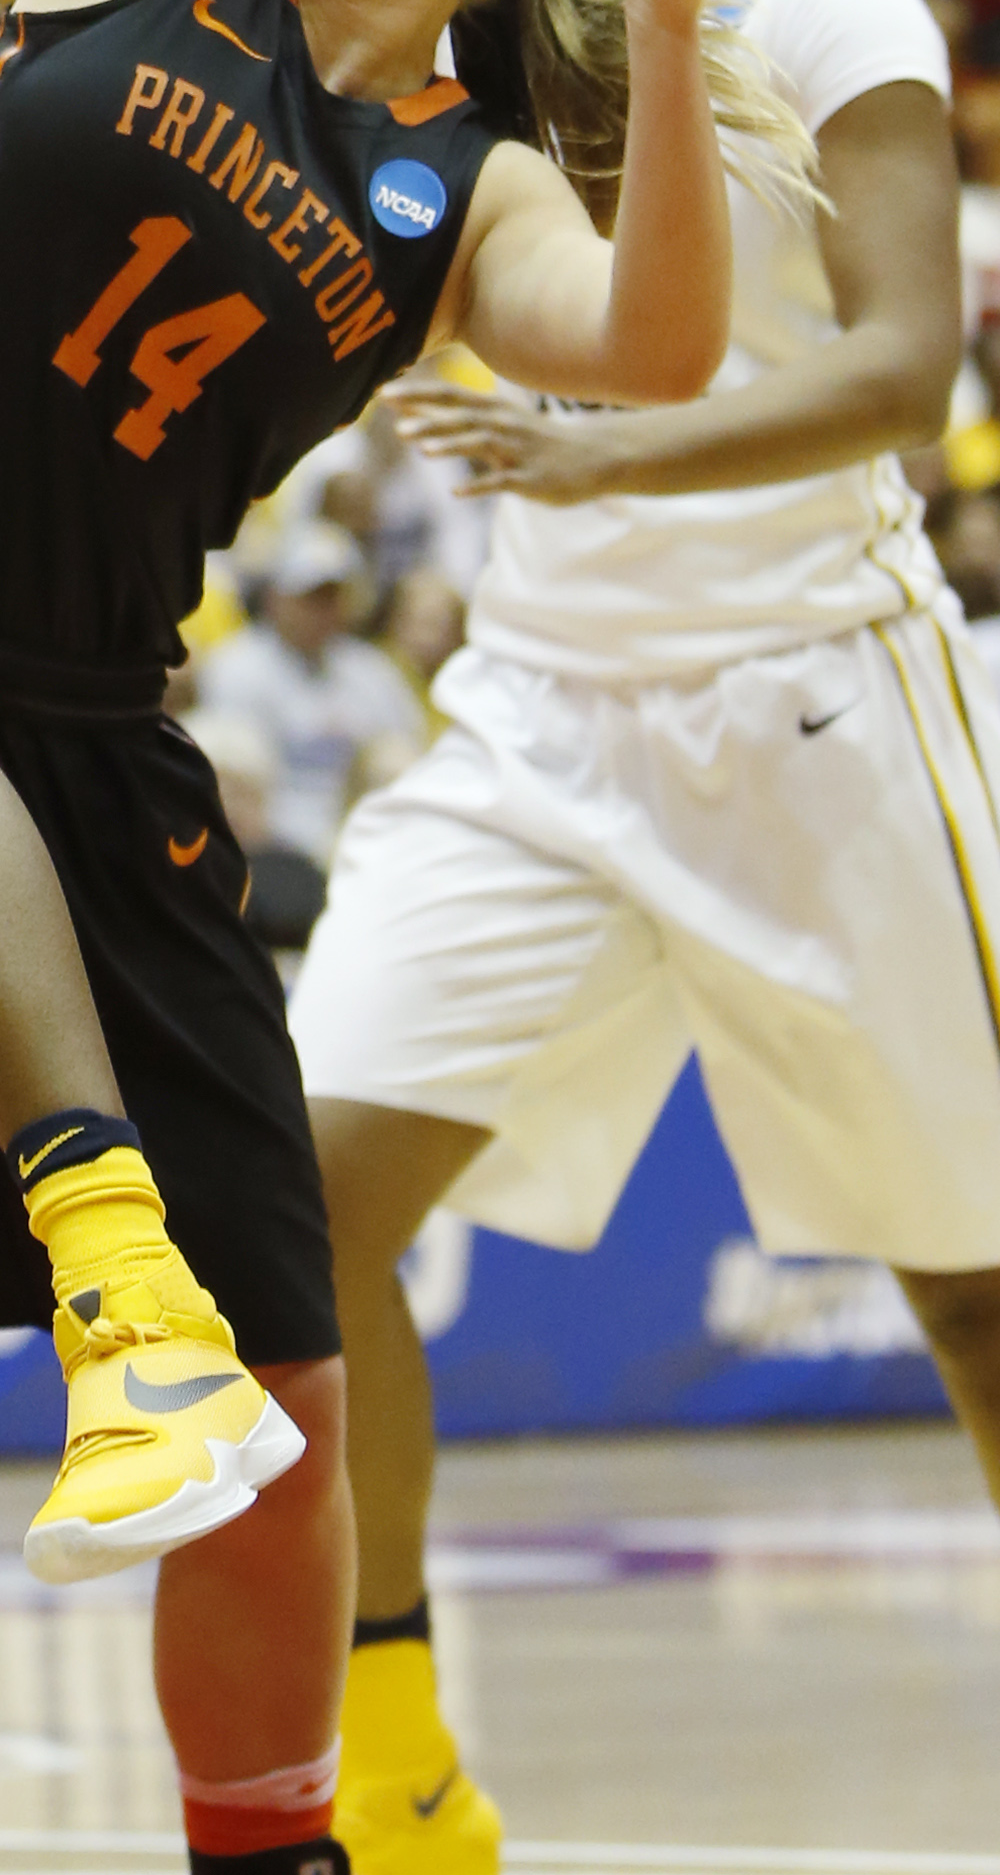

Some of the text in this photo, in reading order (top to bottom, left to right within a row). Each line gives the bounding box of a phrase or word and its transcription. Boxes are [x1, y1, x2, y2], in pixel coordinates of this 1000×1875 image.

[115, 62, 397, 364] PRINCETON
[374, 185, 437, 231] NCAA
[50, 215, 268, 462] 14
